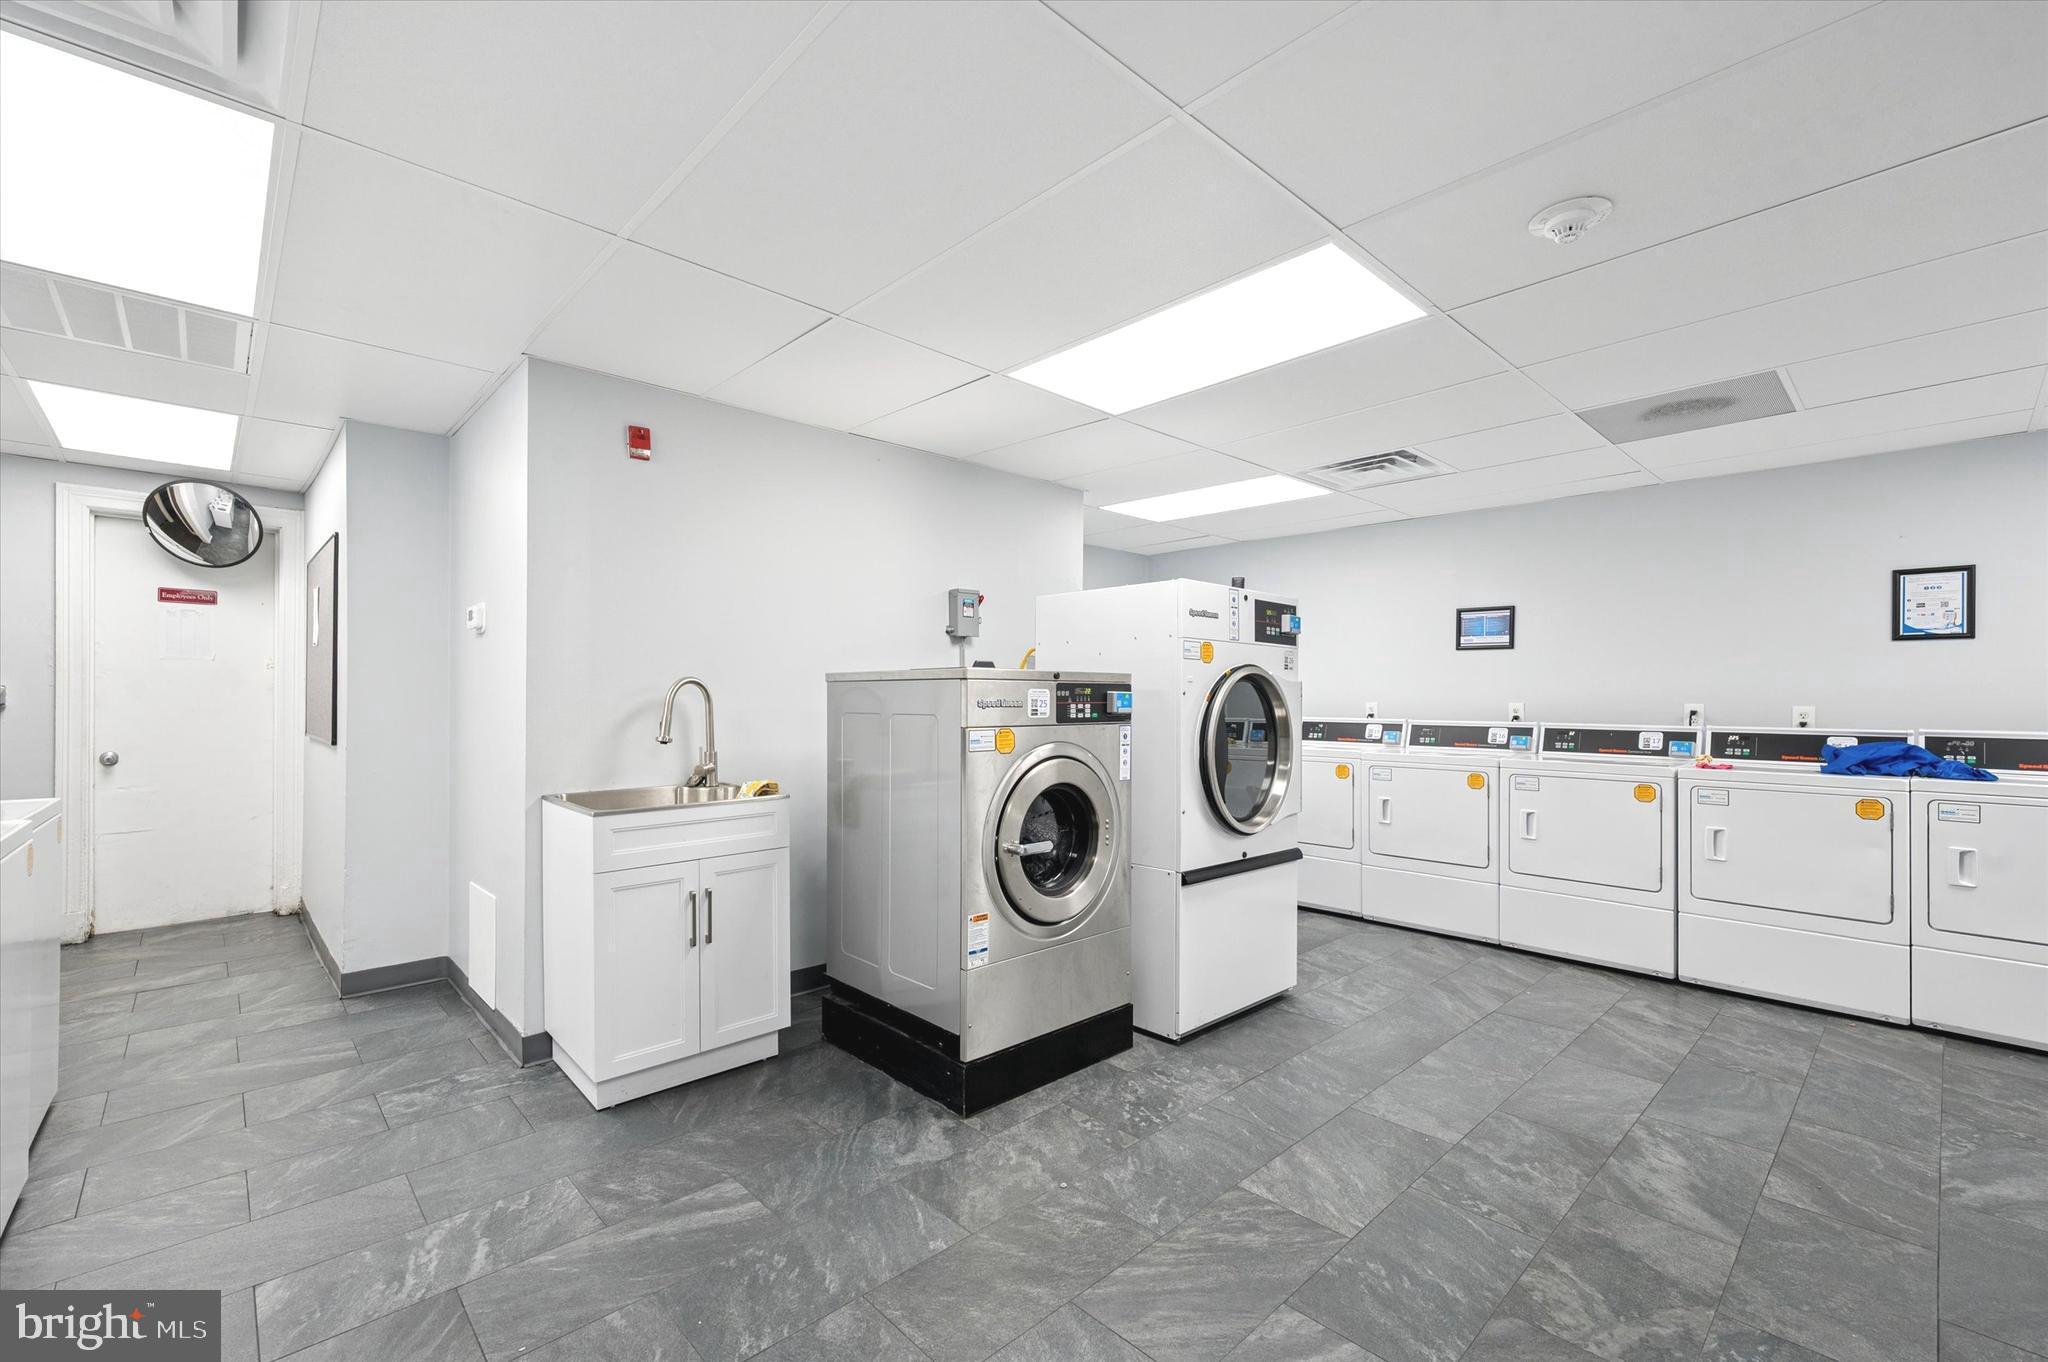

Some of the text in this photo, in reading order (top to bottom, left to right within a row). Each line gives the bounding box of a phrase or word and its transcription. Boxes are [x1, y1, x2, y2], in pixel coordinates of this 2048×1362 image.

[161, 591, 196, 600] Employees
[976, 698, 1002, 710] Speed
[1038, 699, 1048, 708] 25
